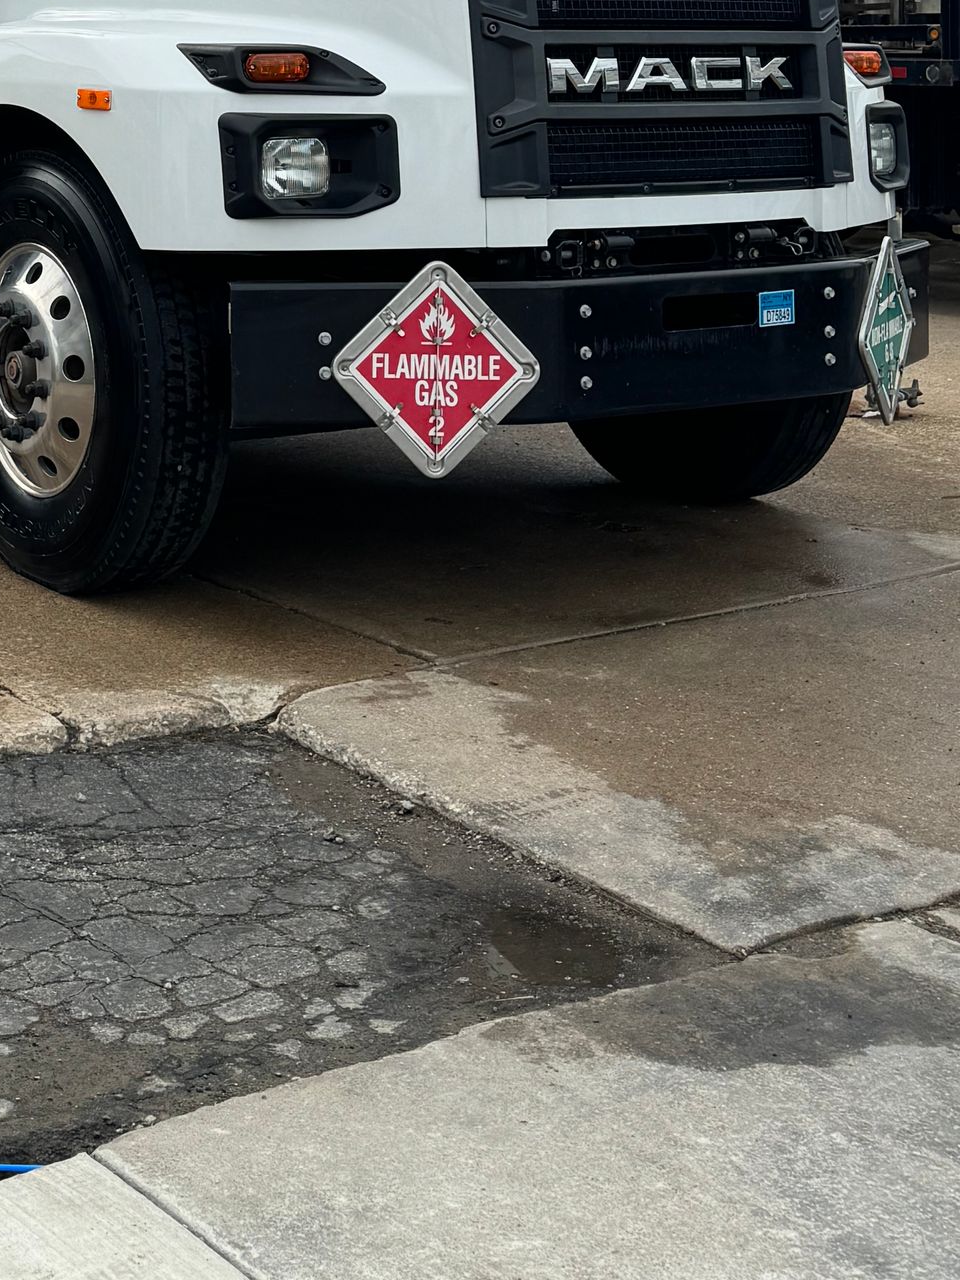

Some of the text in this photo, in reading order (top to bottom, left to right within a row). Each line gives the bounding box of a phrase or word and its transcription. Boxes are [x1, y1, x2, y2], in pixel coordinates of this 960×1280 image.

[546, 56, 794, 94] MACK
[371, 352, 501, 381] FLAMMABLE
[415, 380, 459, 407] GAS
[428, 415, 445, 437] 2
